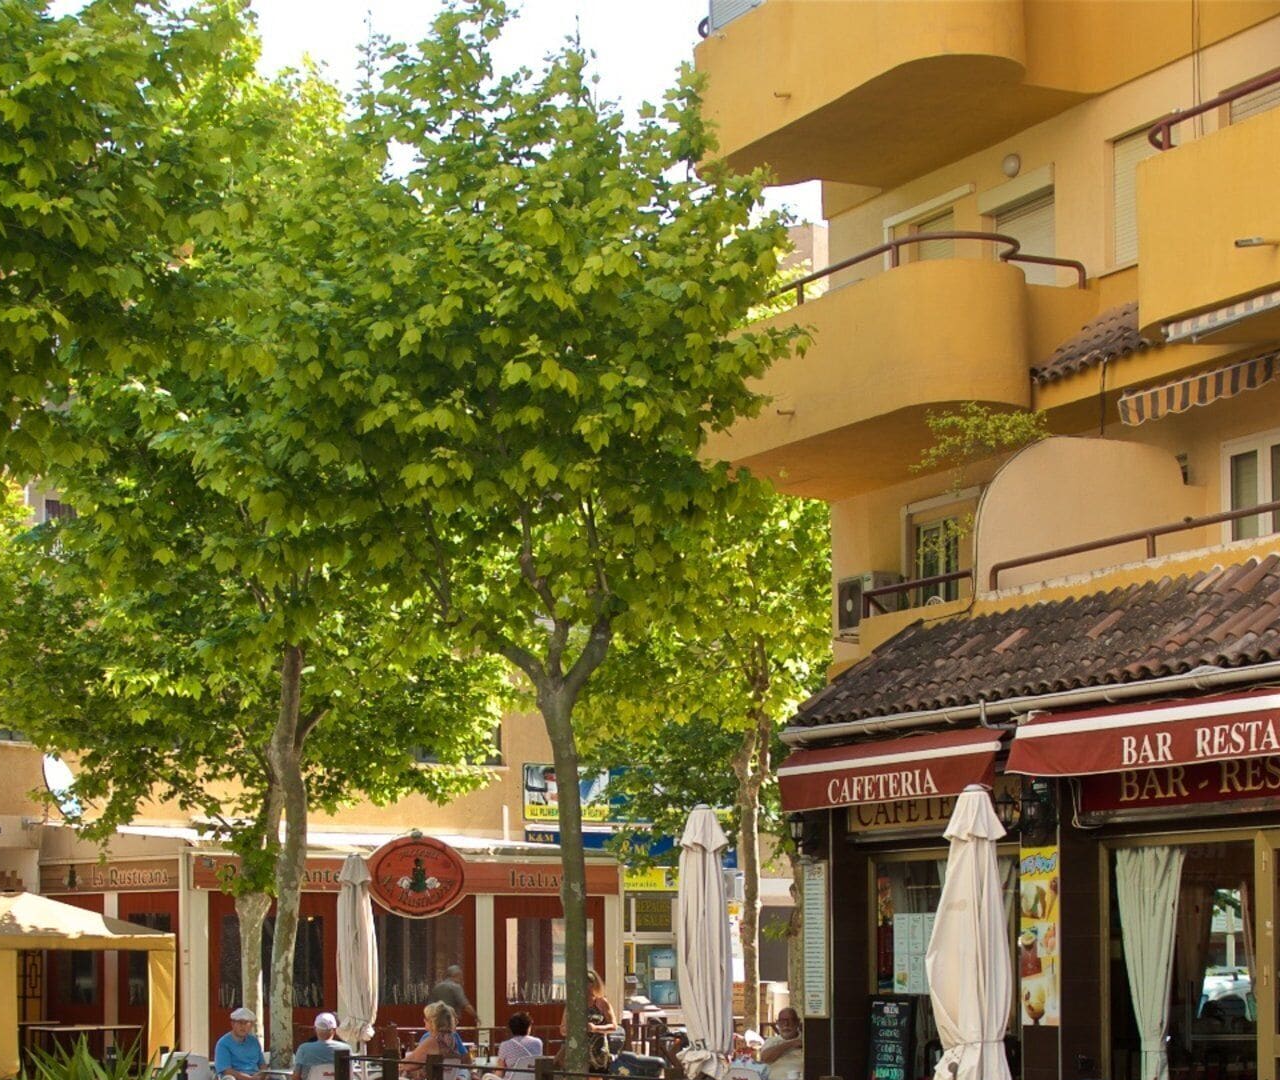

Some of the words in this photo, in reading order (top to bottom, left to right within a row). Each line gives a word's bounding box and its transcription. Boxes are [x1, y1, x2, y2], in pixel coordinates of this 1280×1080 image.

[1121, 732, 1173, 765] BAR
[827, 768, 939, 804] CAFETERIA
[1120, 765, 1189, 801] BAR
